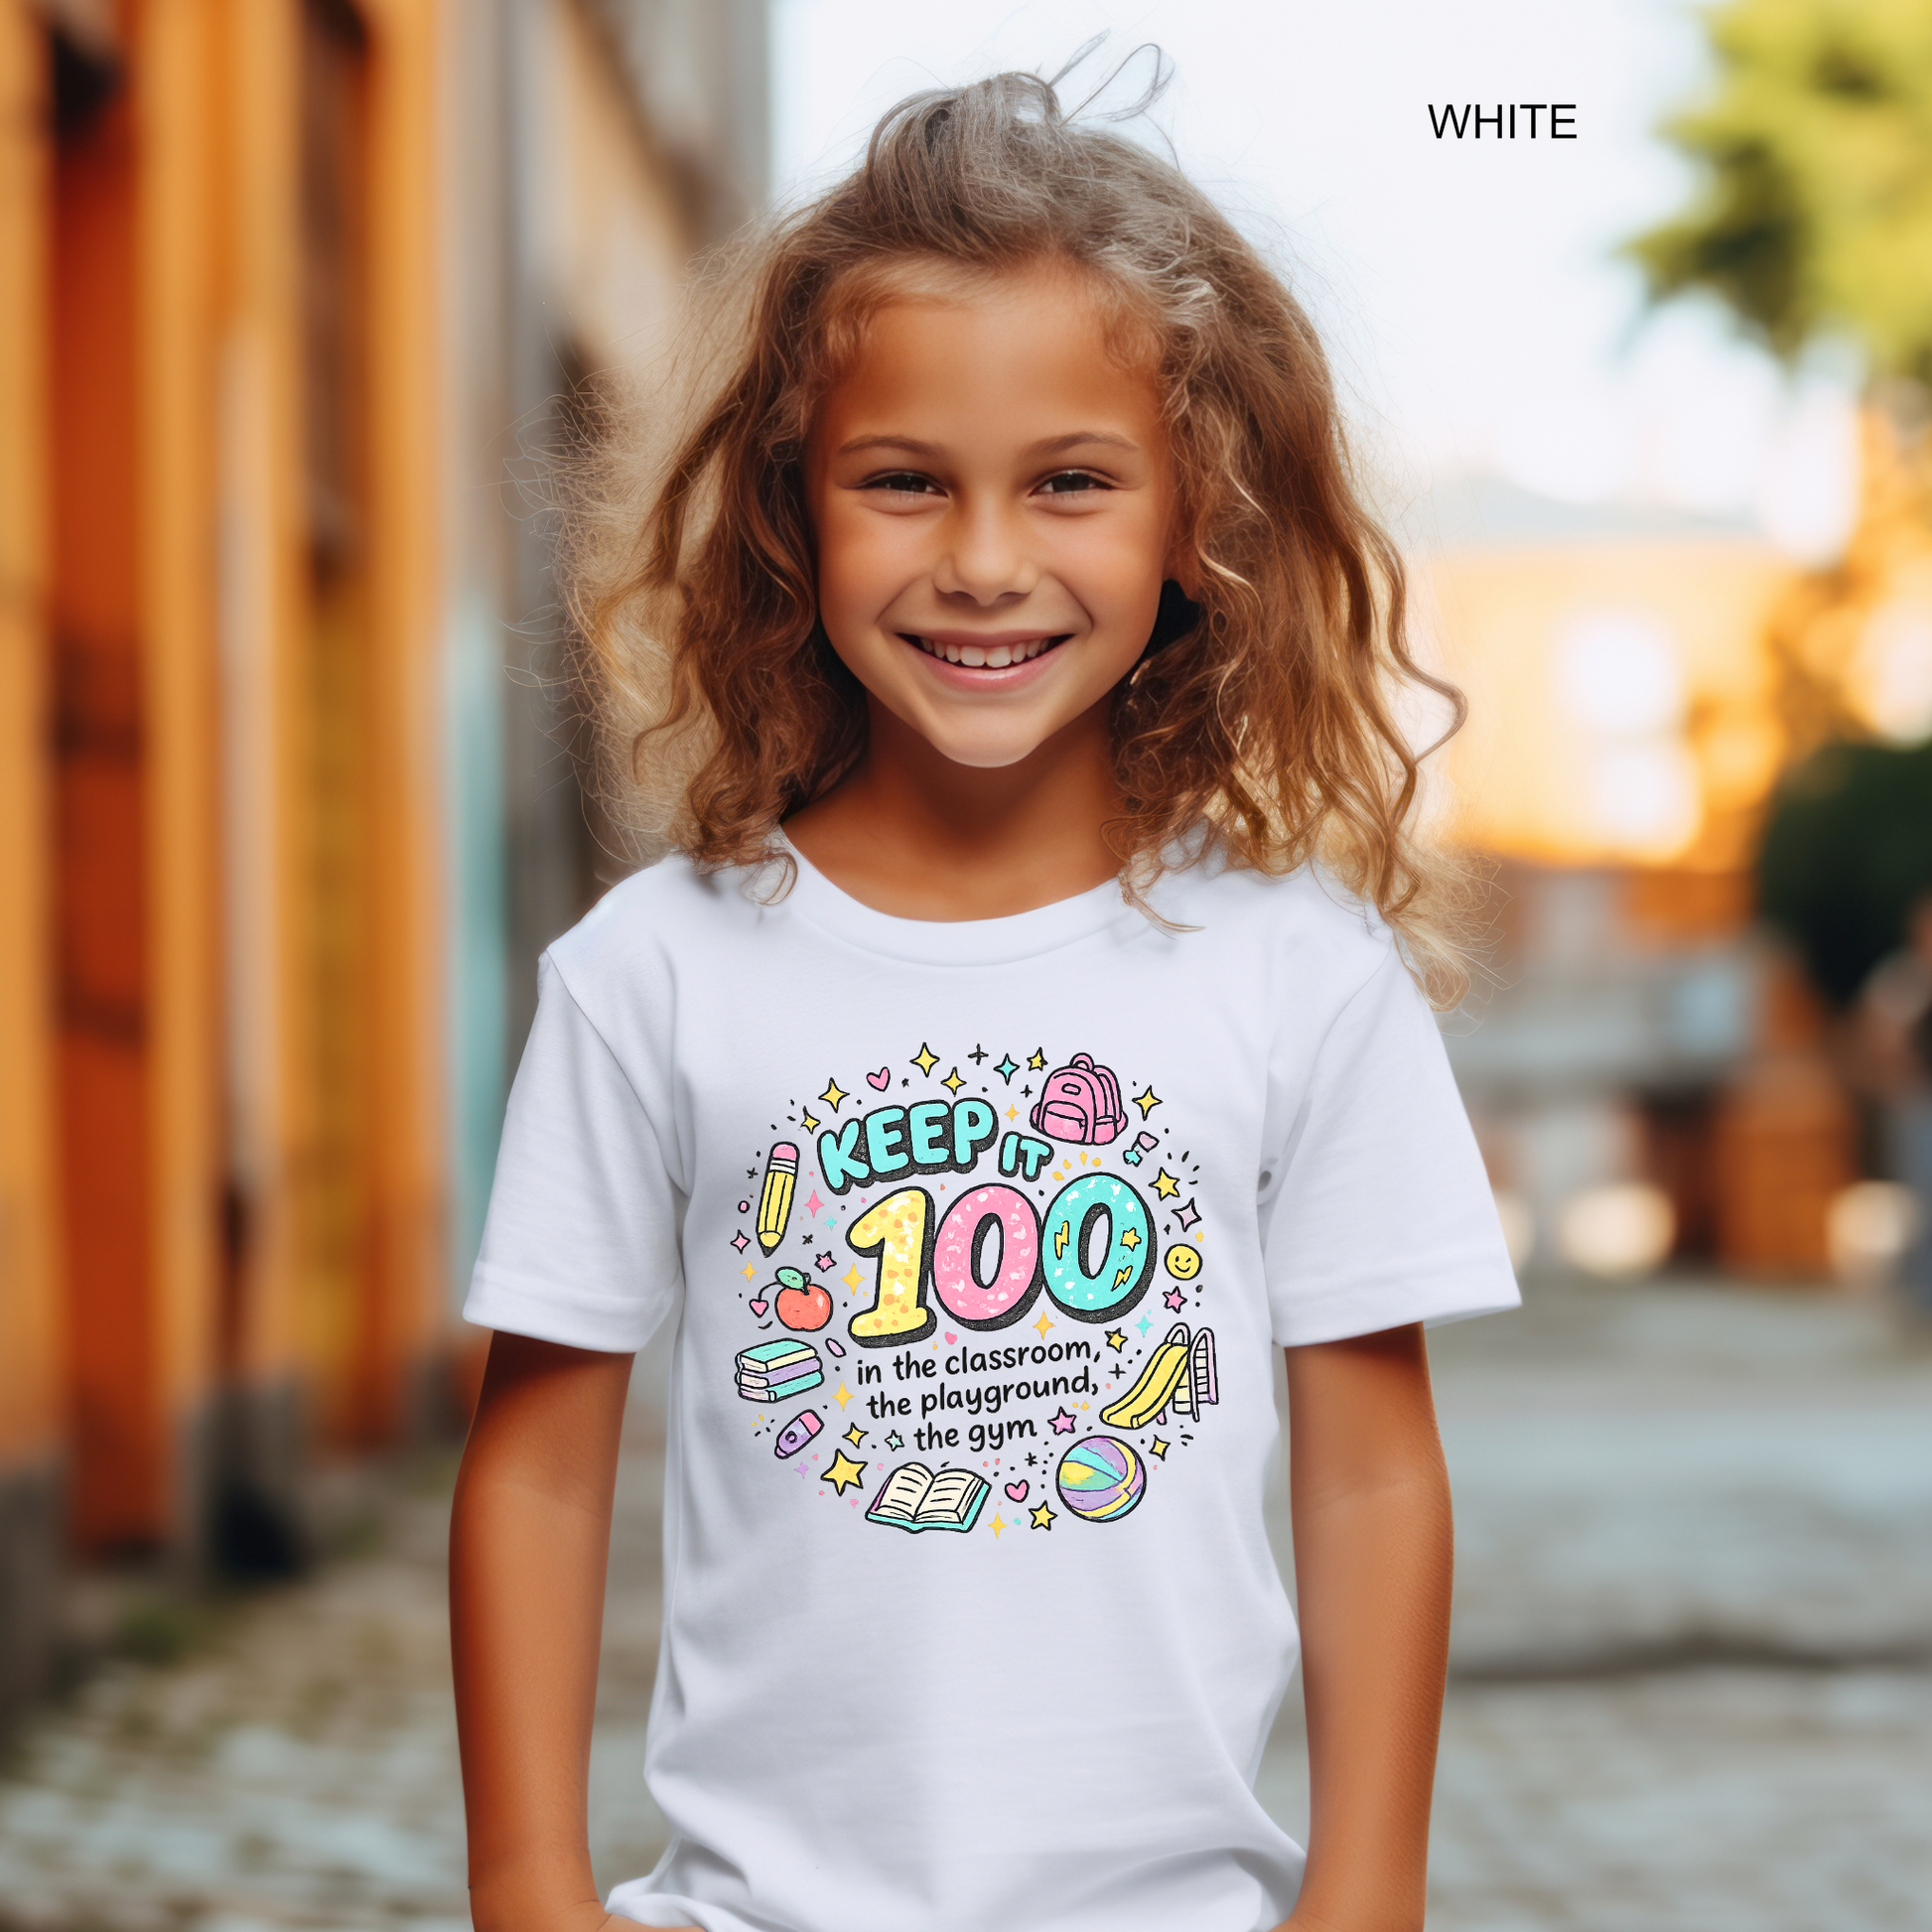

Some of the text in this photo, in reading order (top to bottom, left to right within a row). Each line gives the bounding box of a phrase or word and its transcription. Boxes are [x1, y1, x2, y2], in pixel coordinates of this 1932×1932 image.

[817, 1097, 1053, 1195] KEEP IT
[845, 1172, 1158, 1348] 100
[857, 1340, 1101, 1385] in the classroom,
[866, 1365, 1099, 1420] the playground,
[913, 1419, 1037, 1452] the gym
